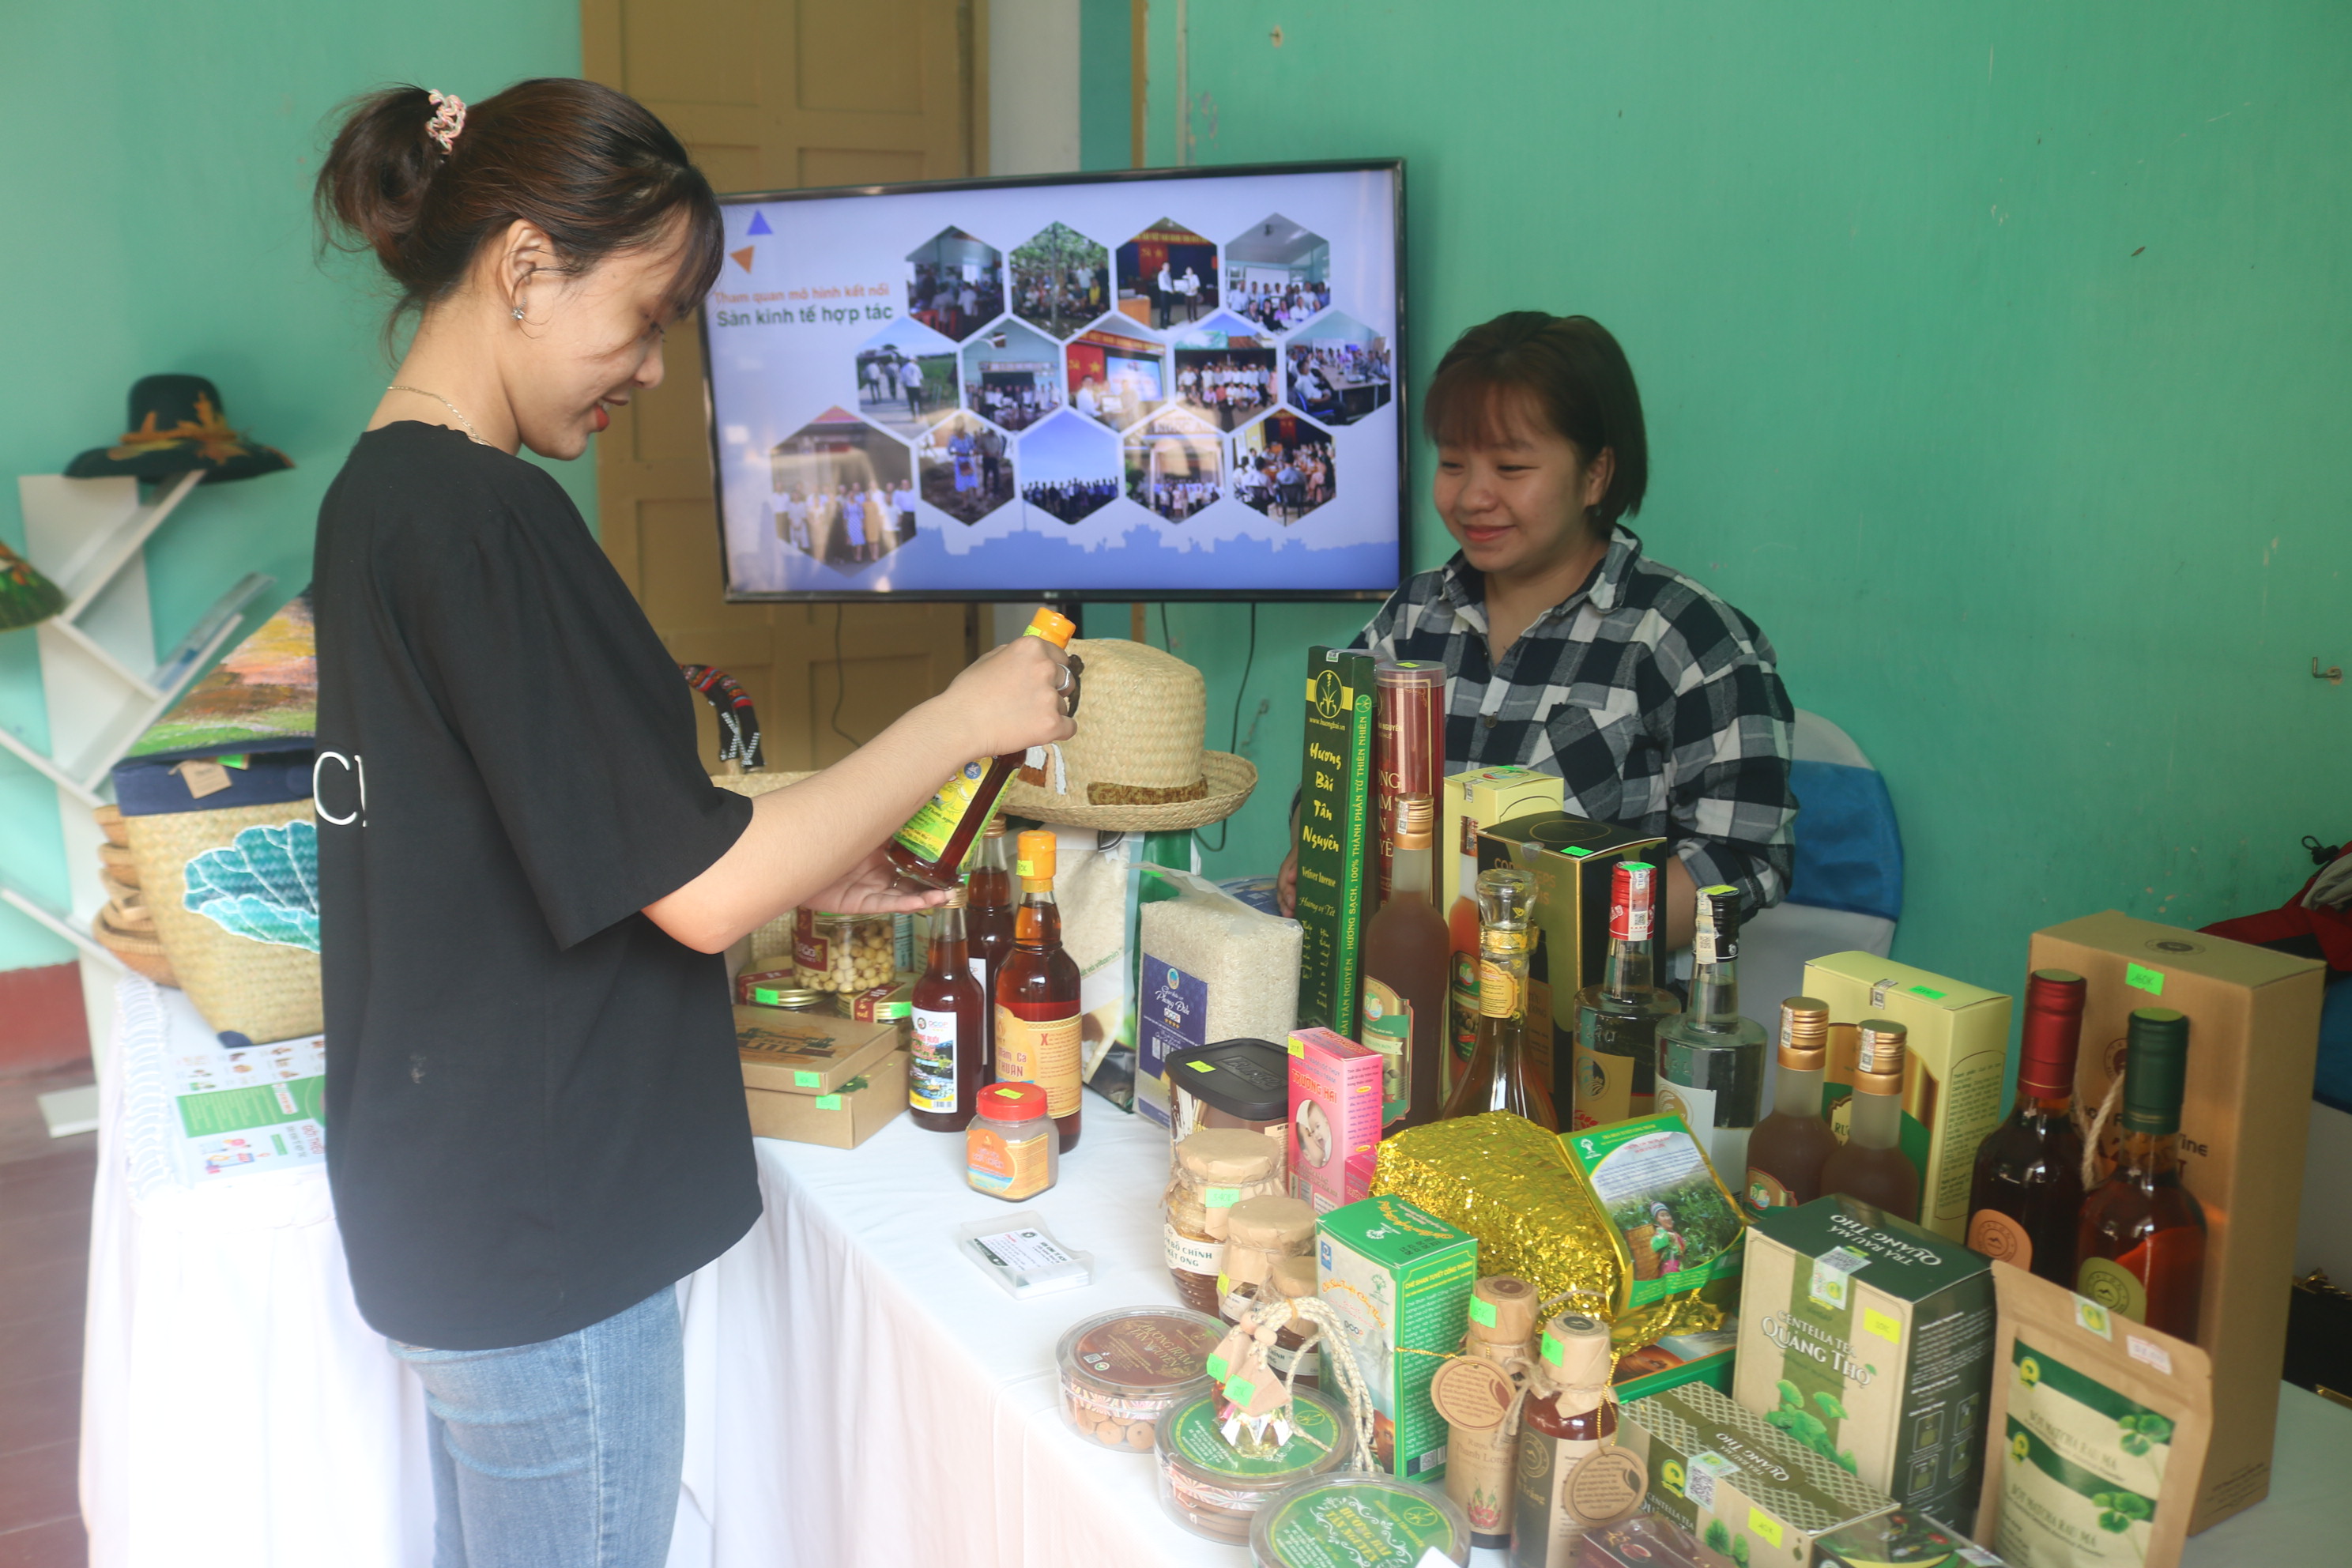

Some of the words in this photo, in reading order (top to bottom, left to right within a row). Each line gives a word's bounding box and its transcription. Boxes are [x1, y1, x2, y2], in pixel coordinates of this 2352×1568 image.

[752, 291, 784, 304] quan
[756, 307, 794, 326] kinh
[799, 304, 816, 323] tế
[822, 304, 859, 325] hợp
[865, 303, 893, 320] tác
[1359, 717, 1367, 746] NHIÊN
[1310, 742, 1342, 770] Hương
[1357, 748, 1366, 777] THIÊN
[1315, 771, 1333, 792] Bài
[1355, 780, 1364, 792] TỪ
[1314, 800, 1332, 820] Tân
[1354, 794, 1363, 821] PHẦN
[1303, 825, 1339, 852] Nguyên
[1352, 824, 1362, 858] THÀNH
[1351, 860, 1359, 884] 100%
[1349, 885, 1358, 916] SẠCH,
[1347, 918, 1355, 950] HƯƠNG
[1344, 958, 1353, 996] NGUYÊN
[1826, 1225, 1854, 1238] MÁ
[1830, 1214, 1870, 1236] THỌ
[1182, 1247, 1212, 1260] CHÍNH
[1851, 1236, 1884, 1253] RAU
[1883, 1249, 1914, 1265] TRÀ
[1180, 1255, 1199, 1267] ONG
[1405, 1280, 1415, 1290] CHÈ
[1415, 1276, 1429, 1287] SHAN
[1429, 1269, 1443, 1280] TUYẾT
[1443, 1265, 1457, 1276] CÔNG
[1457, 1260, 1474, 1271] THÀNH
[1777, 1310, 1834, 1346] CENTELLA
[1835, 1338, 1857, 1359] TEA
[1761, 1316, 1826, 1363] QUẢNG
[1831, 1349, 1871, 1389] THỌ
[2045, 1421, 2079, 1451] MATCHA
[1646, 1491, 1679, 1519] CENTELLA
[1679, 1514, 1695, 1529] TEA
